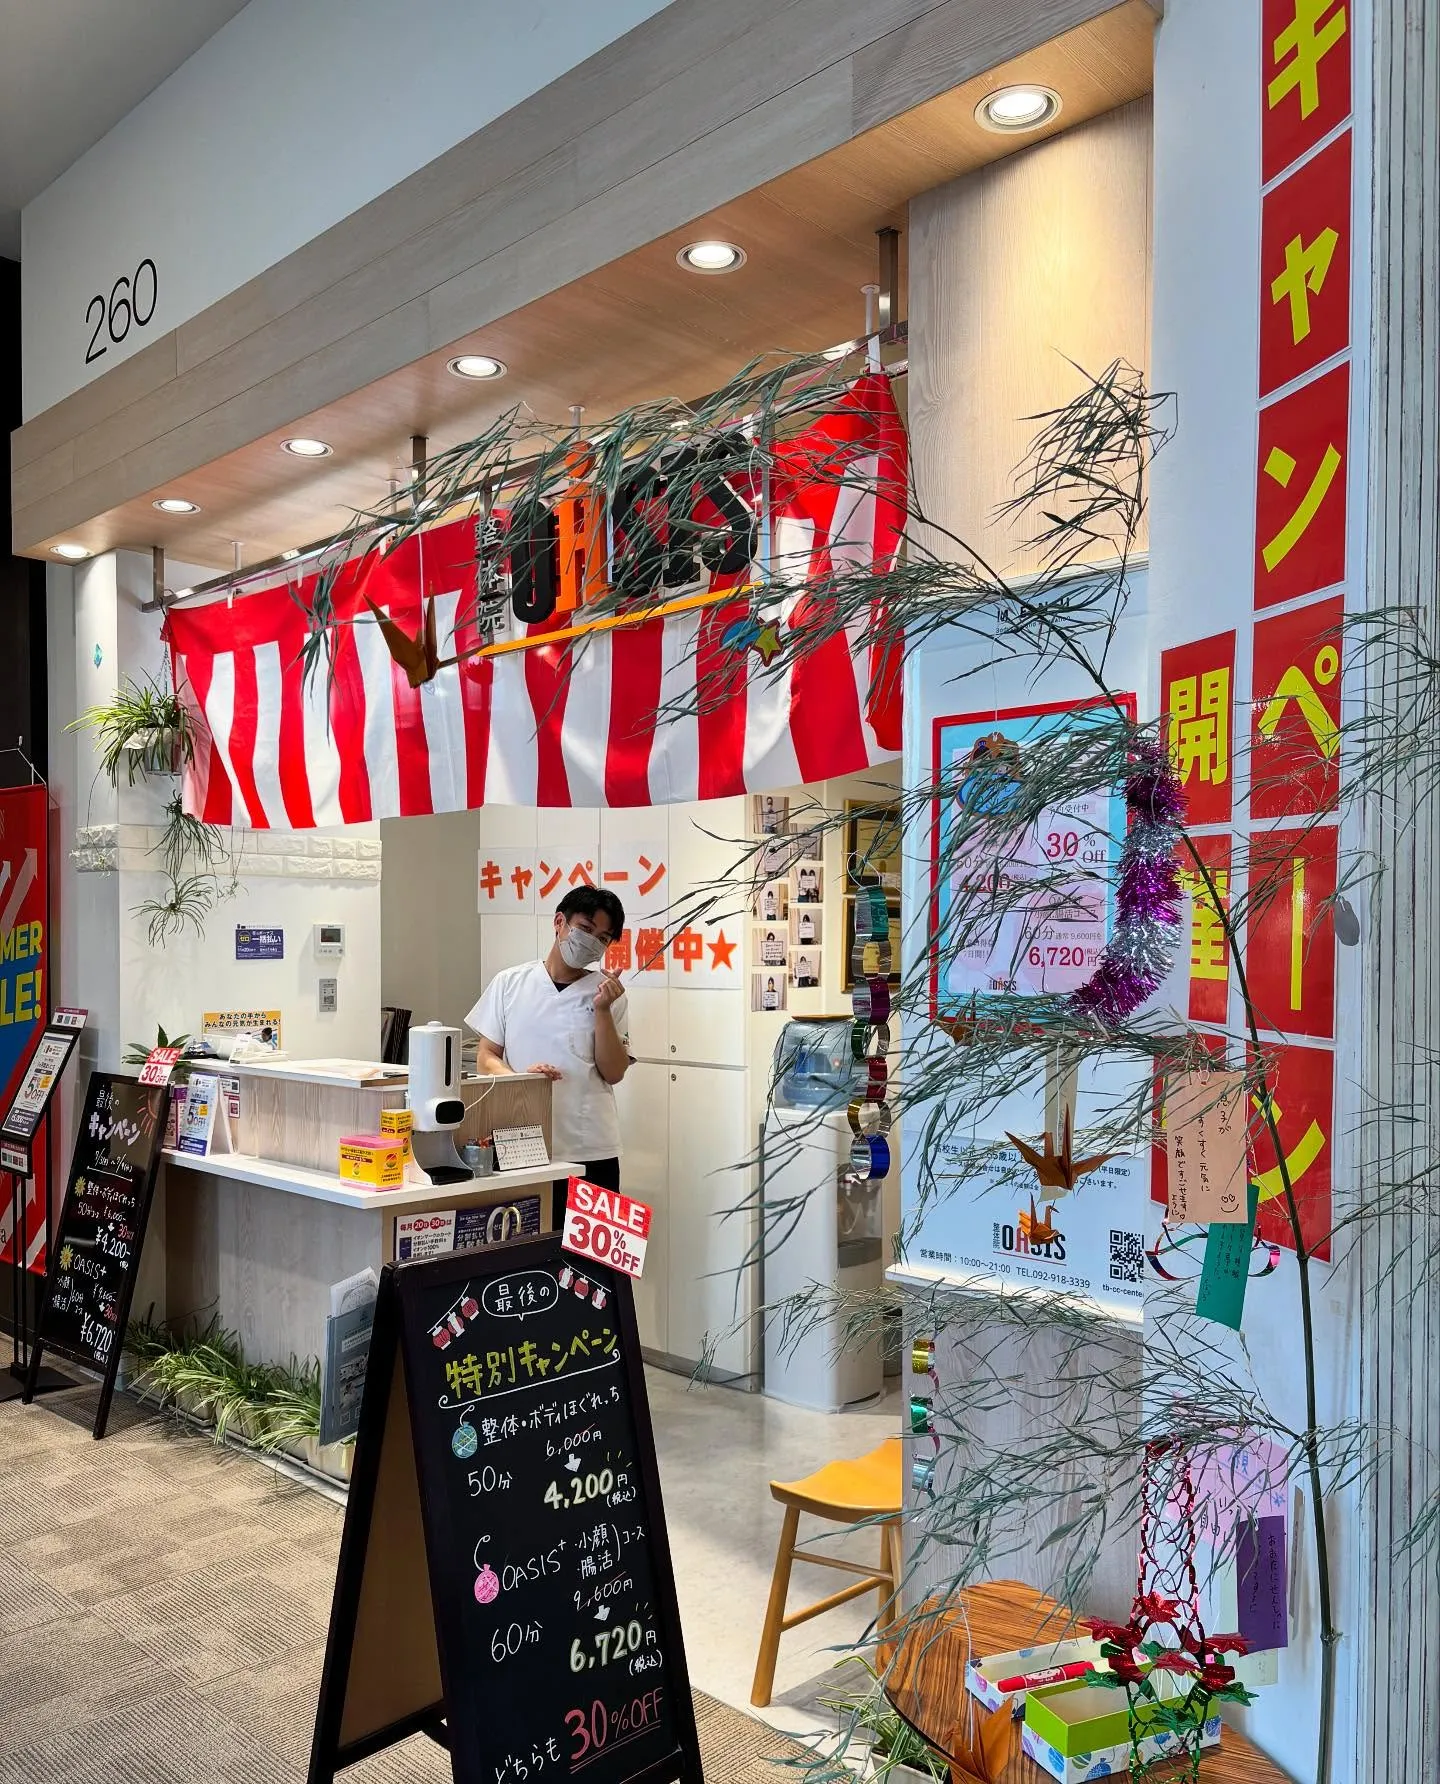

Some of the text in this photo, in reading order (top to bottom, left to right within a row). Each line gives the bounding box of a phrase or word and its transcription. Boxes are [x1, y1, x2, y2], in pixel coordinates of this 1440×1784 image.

[85, 259, 157, 364] 260
[1083, 850, 1106, 863] Off
[480, 855, 666, 900] キャンペーン
[605, 927, 702, 973] 開催中
[219, 1012, 267, 1020] あなたの手から
[151, 1048, 179, 1064] SALE
[89, 1112, 140, 1146] キャンペーン
[575, 1183, 646, 1232] SALE
[610, 1247, 641, 1273] OFF
[1016, 1266, 1090, 1290] TEL.092-918-3339
[495, 1283, 550, 1312] 最後の
[445, 1328, 617, 1399] 特別キャンペーン
[546, 1429, 602, 1457] 6,000円
[468, 1465, 628, 1510] 50分 4,200円
[606, 1486, 636, 1507] (税込)
[574, 1577, 633, 1610] 9,600円
[491, 1620, 656, 1673] 60分 6,720円
[629, 1650, 663, 1675] (税込)
[495, 1736, 561, 1784] どちらも
